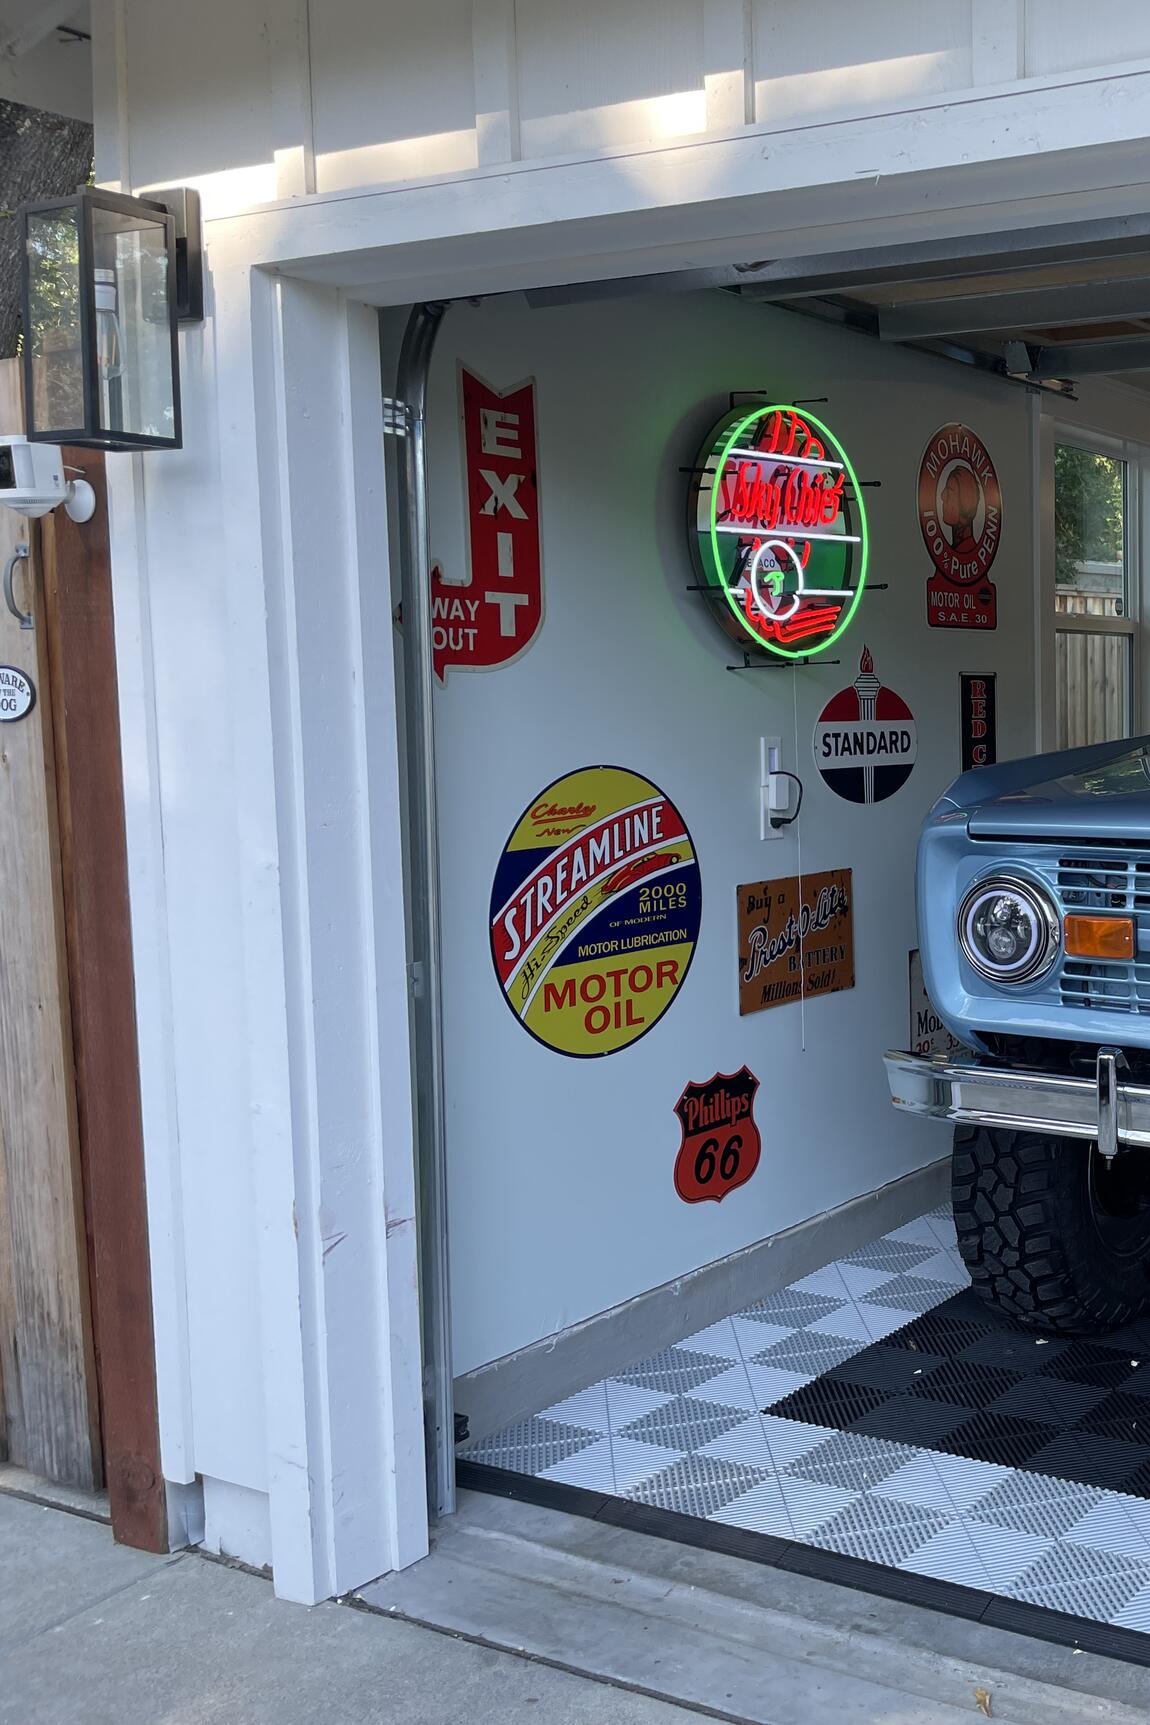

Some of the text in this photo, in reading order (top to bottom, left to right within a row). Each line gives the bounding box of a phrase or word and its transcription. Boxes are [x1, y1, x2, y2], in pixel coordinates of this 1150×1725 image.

[925, 433, 993, 486] MOHAWK
[478, 408, 530, 637] EXIT
[950, 556, 979, 580] Pure
[977, 504, 998, 566] PENN
[432, 598, 480, 622] WAY
[930, 591, 960, 609] MOTOR
[963, 593, 977, 610] OIL
[975, 614, 988, 624] 30
[432, 626, 478, 651] OUT
[0, 671, 26, 693] WARE
[3, 688, 16, 697] THE
[0, 698, 17, 712] OG
[970, 680, 987, 739] RED
[821, 730, 911, 758] STANDARD
[503, 804, 664, 961] STREAMLINE
[639, 883, 687, 901] 2000
[609, 913, 667, 928] OF MODERN
[639, 898, 687, 914] MILES
[746, 892, 785, 924] Buy a
[521, 895, 593, 1001] Hi-Speed
[577, 928, 688, 958] MOTOR LUBRICATION
[788, 944, 846, 973] BATTERY
[543, 959, 680, 1013] MOTOR
[760, 969, 836, 1004] Millions Sold!
[584, 999, 645, 1035] OIL
[684, 1088, 750, 1131] Phillips
[694, 1134, 743, 1185] 66
